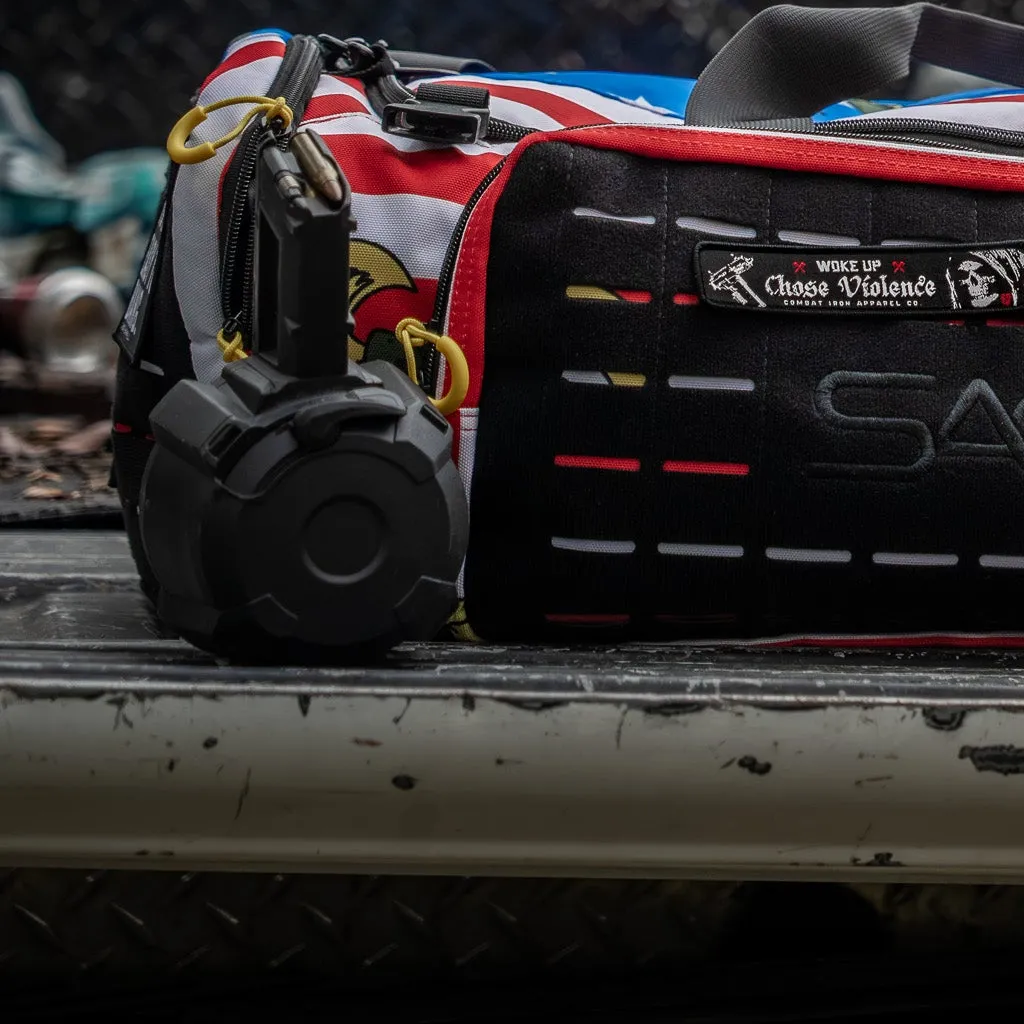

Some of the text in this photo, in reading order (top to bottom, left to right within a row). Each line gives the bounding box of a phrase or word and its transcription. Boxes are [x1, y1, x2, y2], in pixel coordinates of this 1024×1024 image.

[816, 260, 882, 273] WOKE UP
[764, 275, 937, 298] Chose Violence
[783, 299, 823, 307] COMBAT
